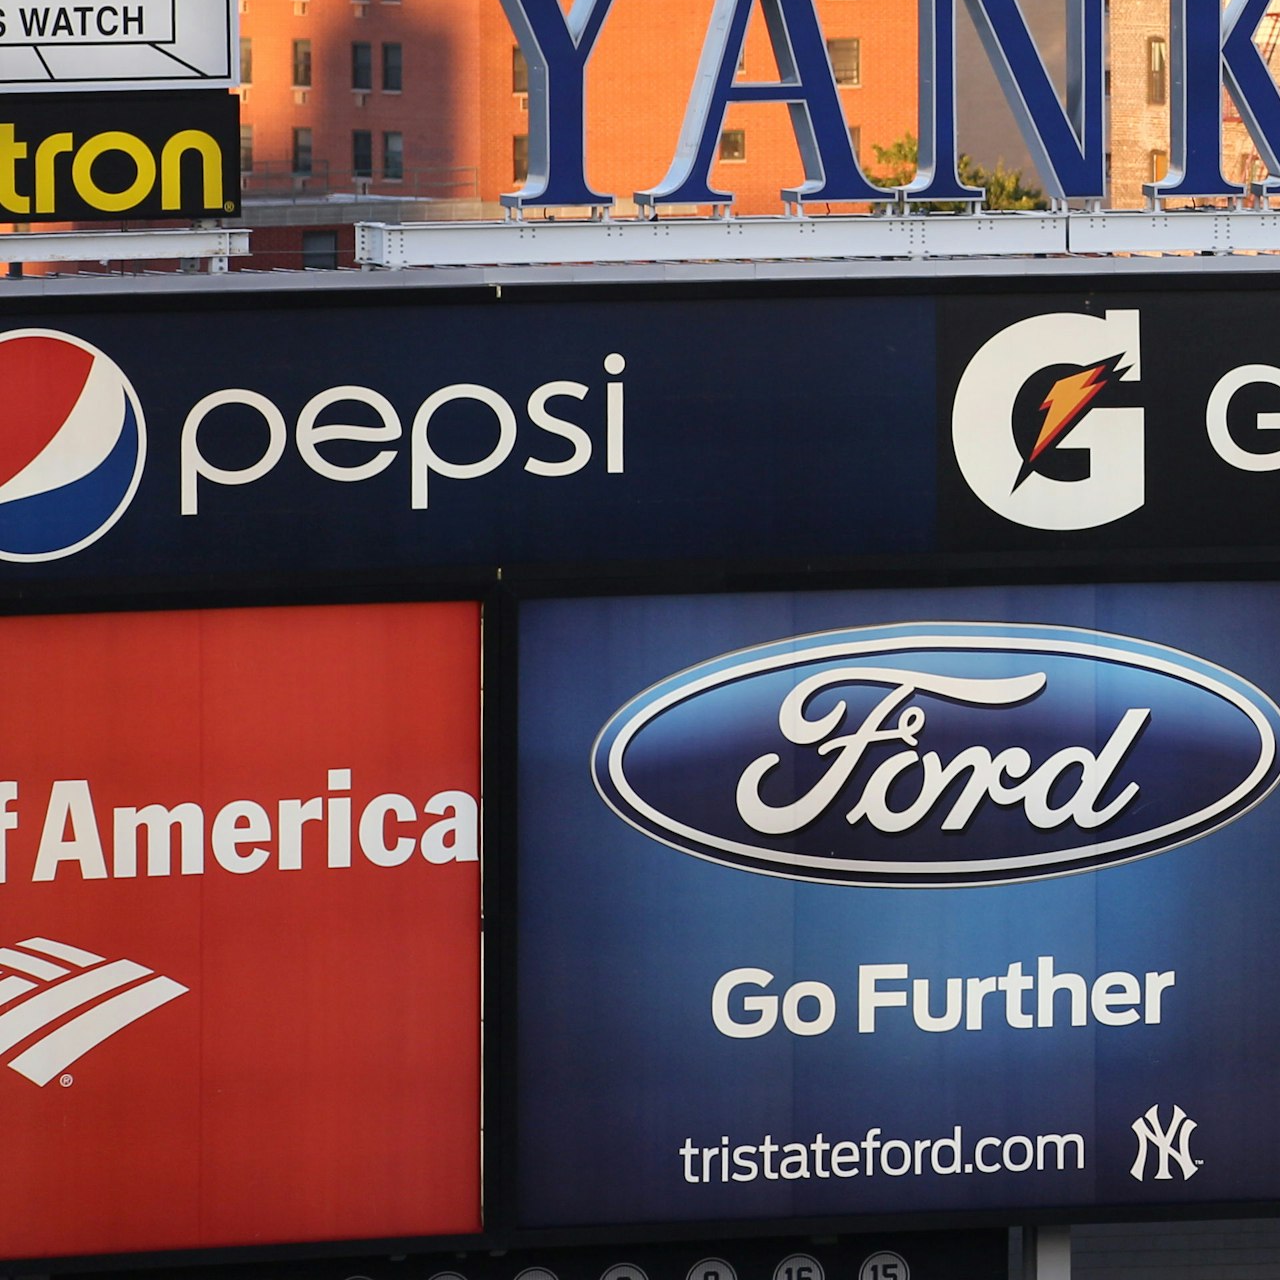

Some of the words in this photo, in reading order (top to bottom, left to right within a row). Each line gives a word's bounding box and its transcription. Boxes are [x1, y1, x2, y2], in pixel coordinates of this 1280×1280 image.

[18, 5, 144, 37] WATCH
[181, 352, 626, 516] pepsi
[952, 309, 1146, 531] G
[735, 666, 1151, 834] Ford
[32, 769, 480, 882] America
[711, 967, 837, 1039] Go
[858, 955, 1176, 1033] Further
[680, 1125, 1085, 1184] tristateford.com
